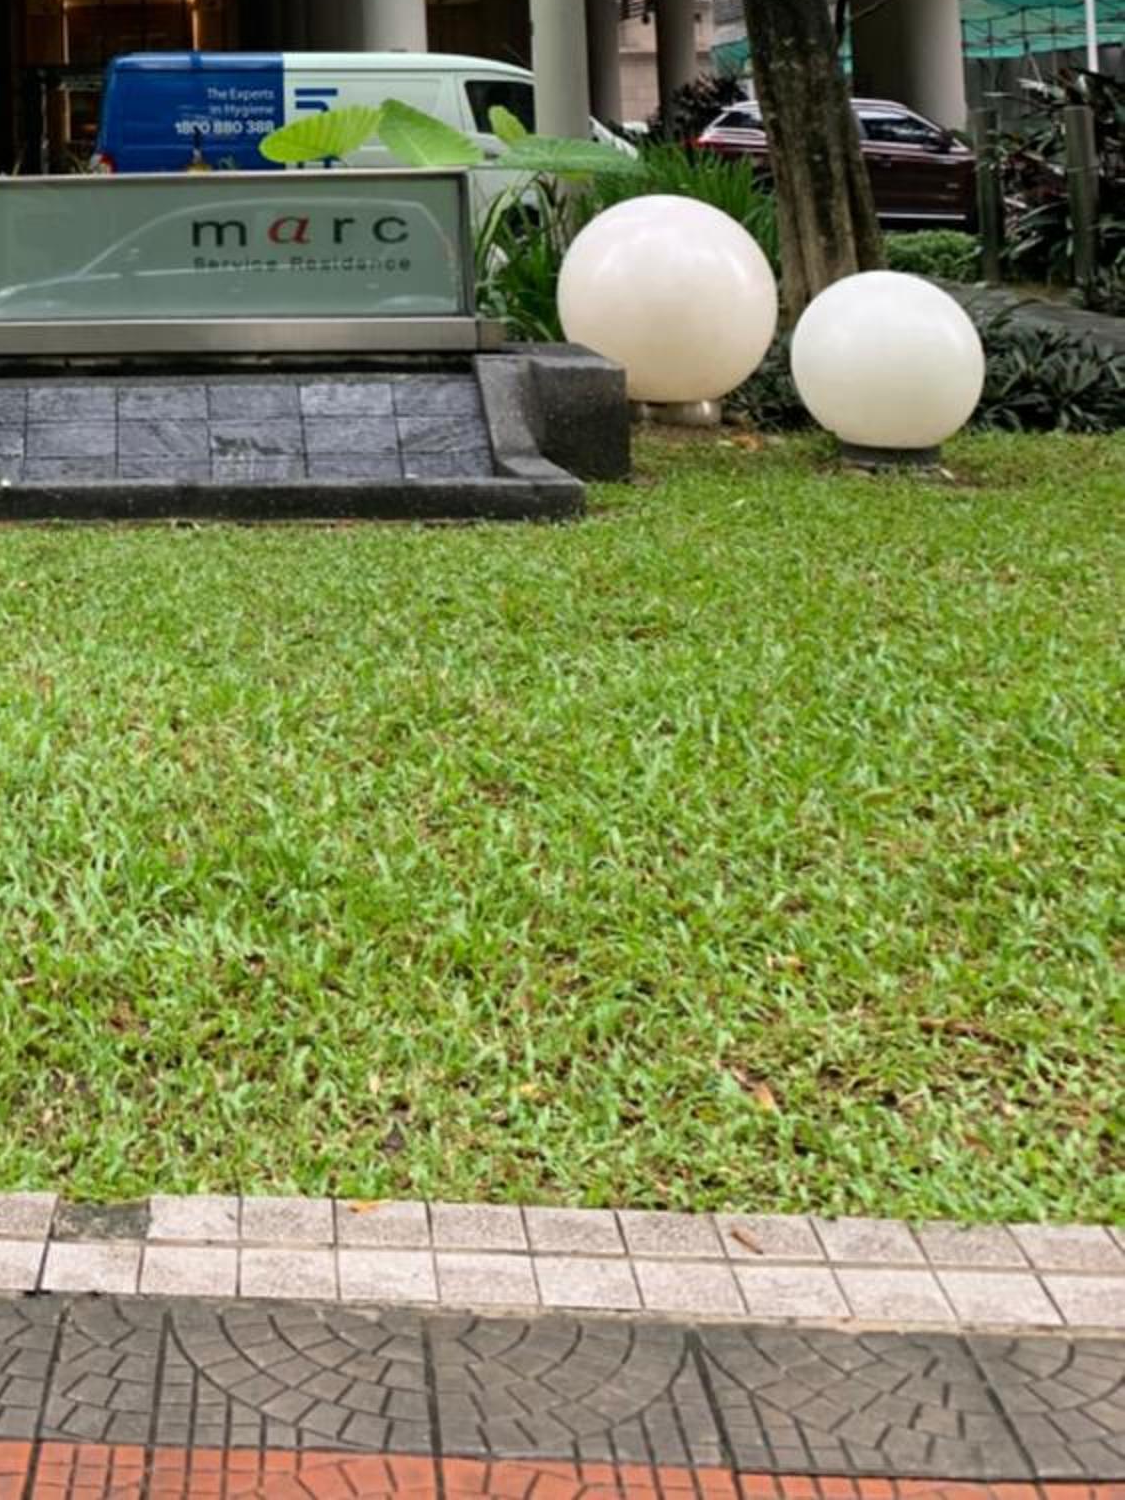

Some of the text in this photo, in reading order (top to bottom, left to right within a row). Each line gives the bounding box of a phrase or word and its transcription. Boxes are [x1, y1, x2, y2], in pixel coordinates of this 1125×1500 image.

[207, 88, 274, 101] The Experts
[174, 120, 211, 134] 1800
[192, 215, 409, 247] marc
[194, 256, 411, 271] Service Residence
